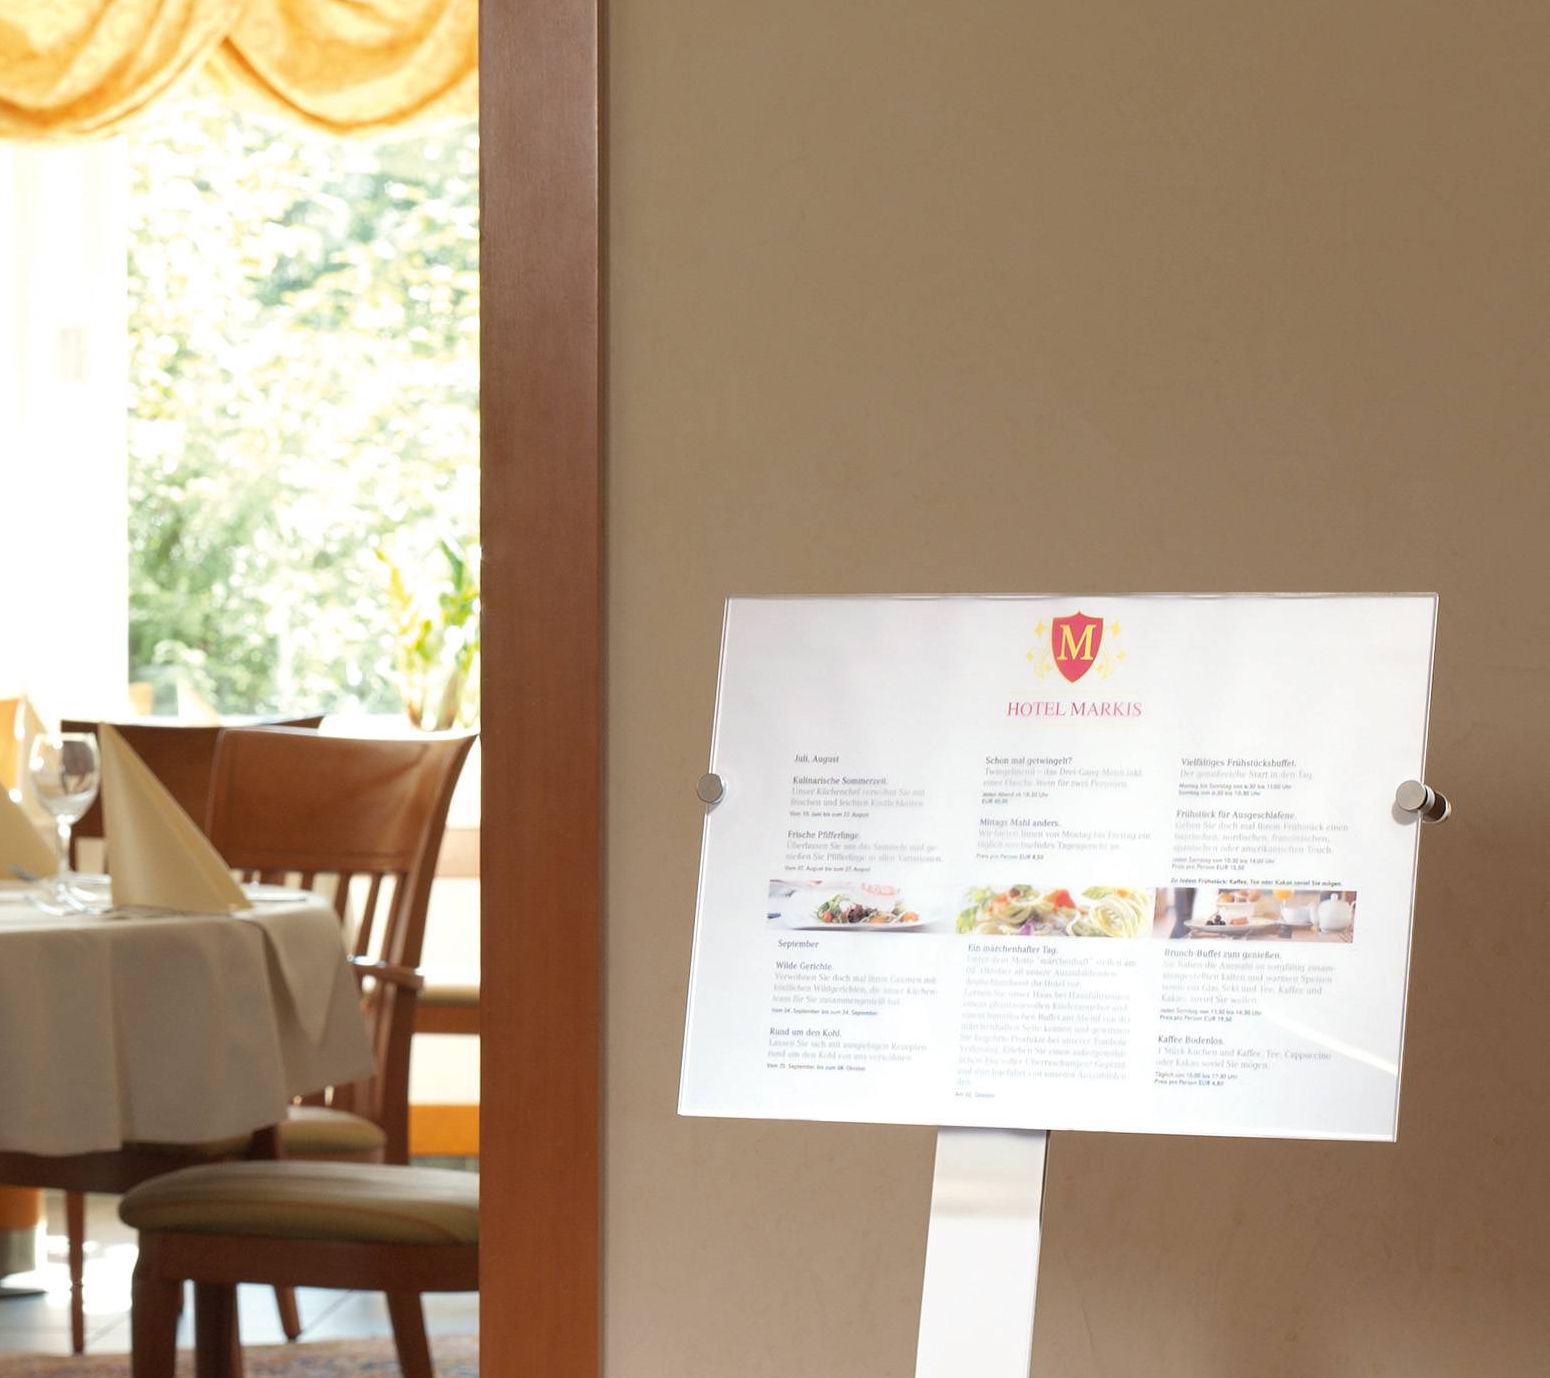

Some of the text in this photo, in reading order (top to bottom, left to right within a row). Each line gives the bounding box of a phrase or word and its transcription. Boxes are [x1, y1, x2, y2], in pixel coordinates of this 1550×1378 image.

[1057, 624, 1097, 661] M
[1007, 701, 1143, 717] HOTEL MARKIS
[813, 755, 839, 764] August
[1181, 758, 1224, 768] Vielfältiges
[793, 776, 840, 784] Kulinarische
[1176, 810, 1215, 818] Frühstück
[1218, 810, 1229, 818] für
[787, 830, 815, 838] Frische
[778, 939, 819, 950] September
[968, 944, 981, 952] Ein
[1223, 951, 1240, 959] zum
[776, 962, 797, 970] Wilde
[770, 1028, 790, 1036] Rund
[792, 1028, 804, 1036] um
[806, 1028, 820, 1036] den
[1158, 1035, 1183, 1044] Kaffee
